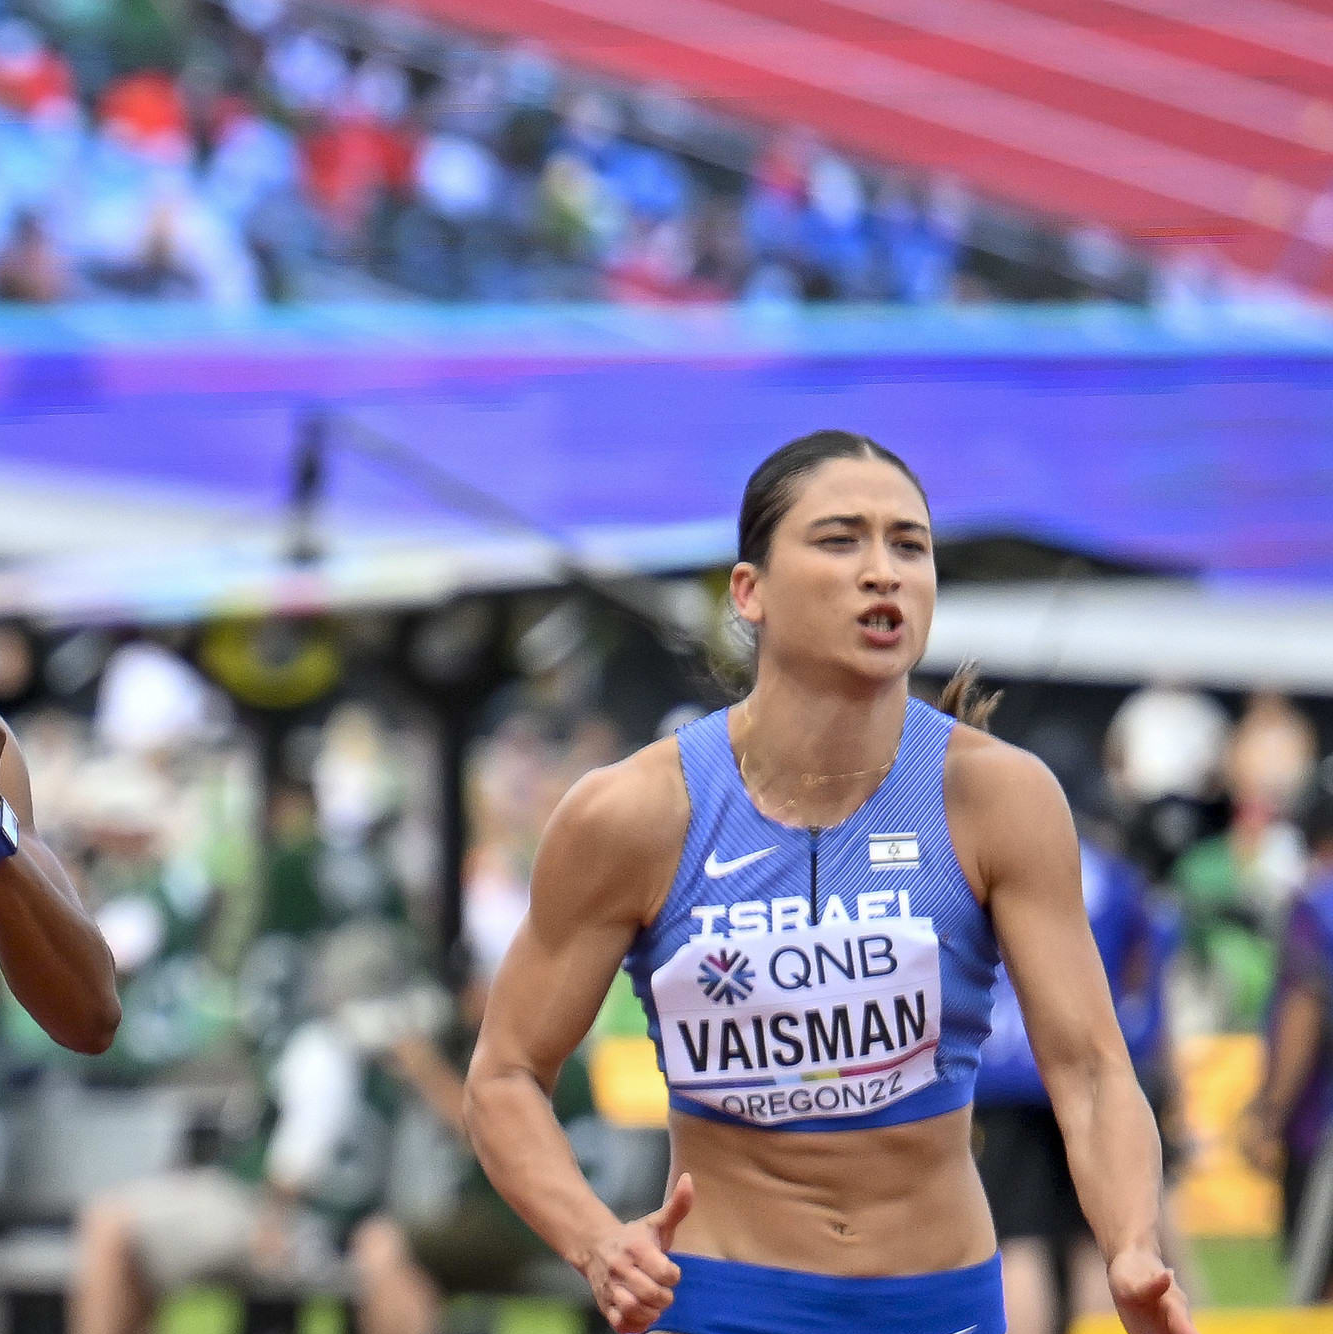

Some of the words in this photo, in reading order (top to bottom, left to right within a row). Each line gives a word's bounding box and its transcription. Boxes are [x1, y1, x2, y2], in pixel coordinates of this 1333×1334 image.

[689, 889, 912, 943] ISRAEL
[769, 933, 898, 990] QNB
[677, 989, 927, 1073] VAISMAN
[722, 1069, 903, 1118] OREGON22
